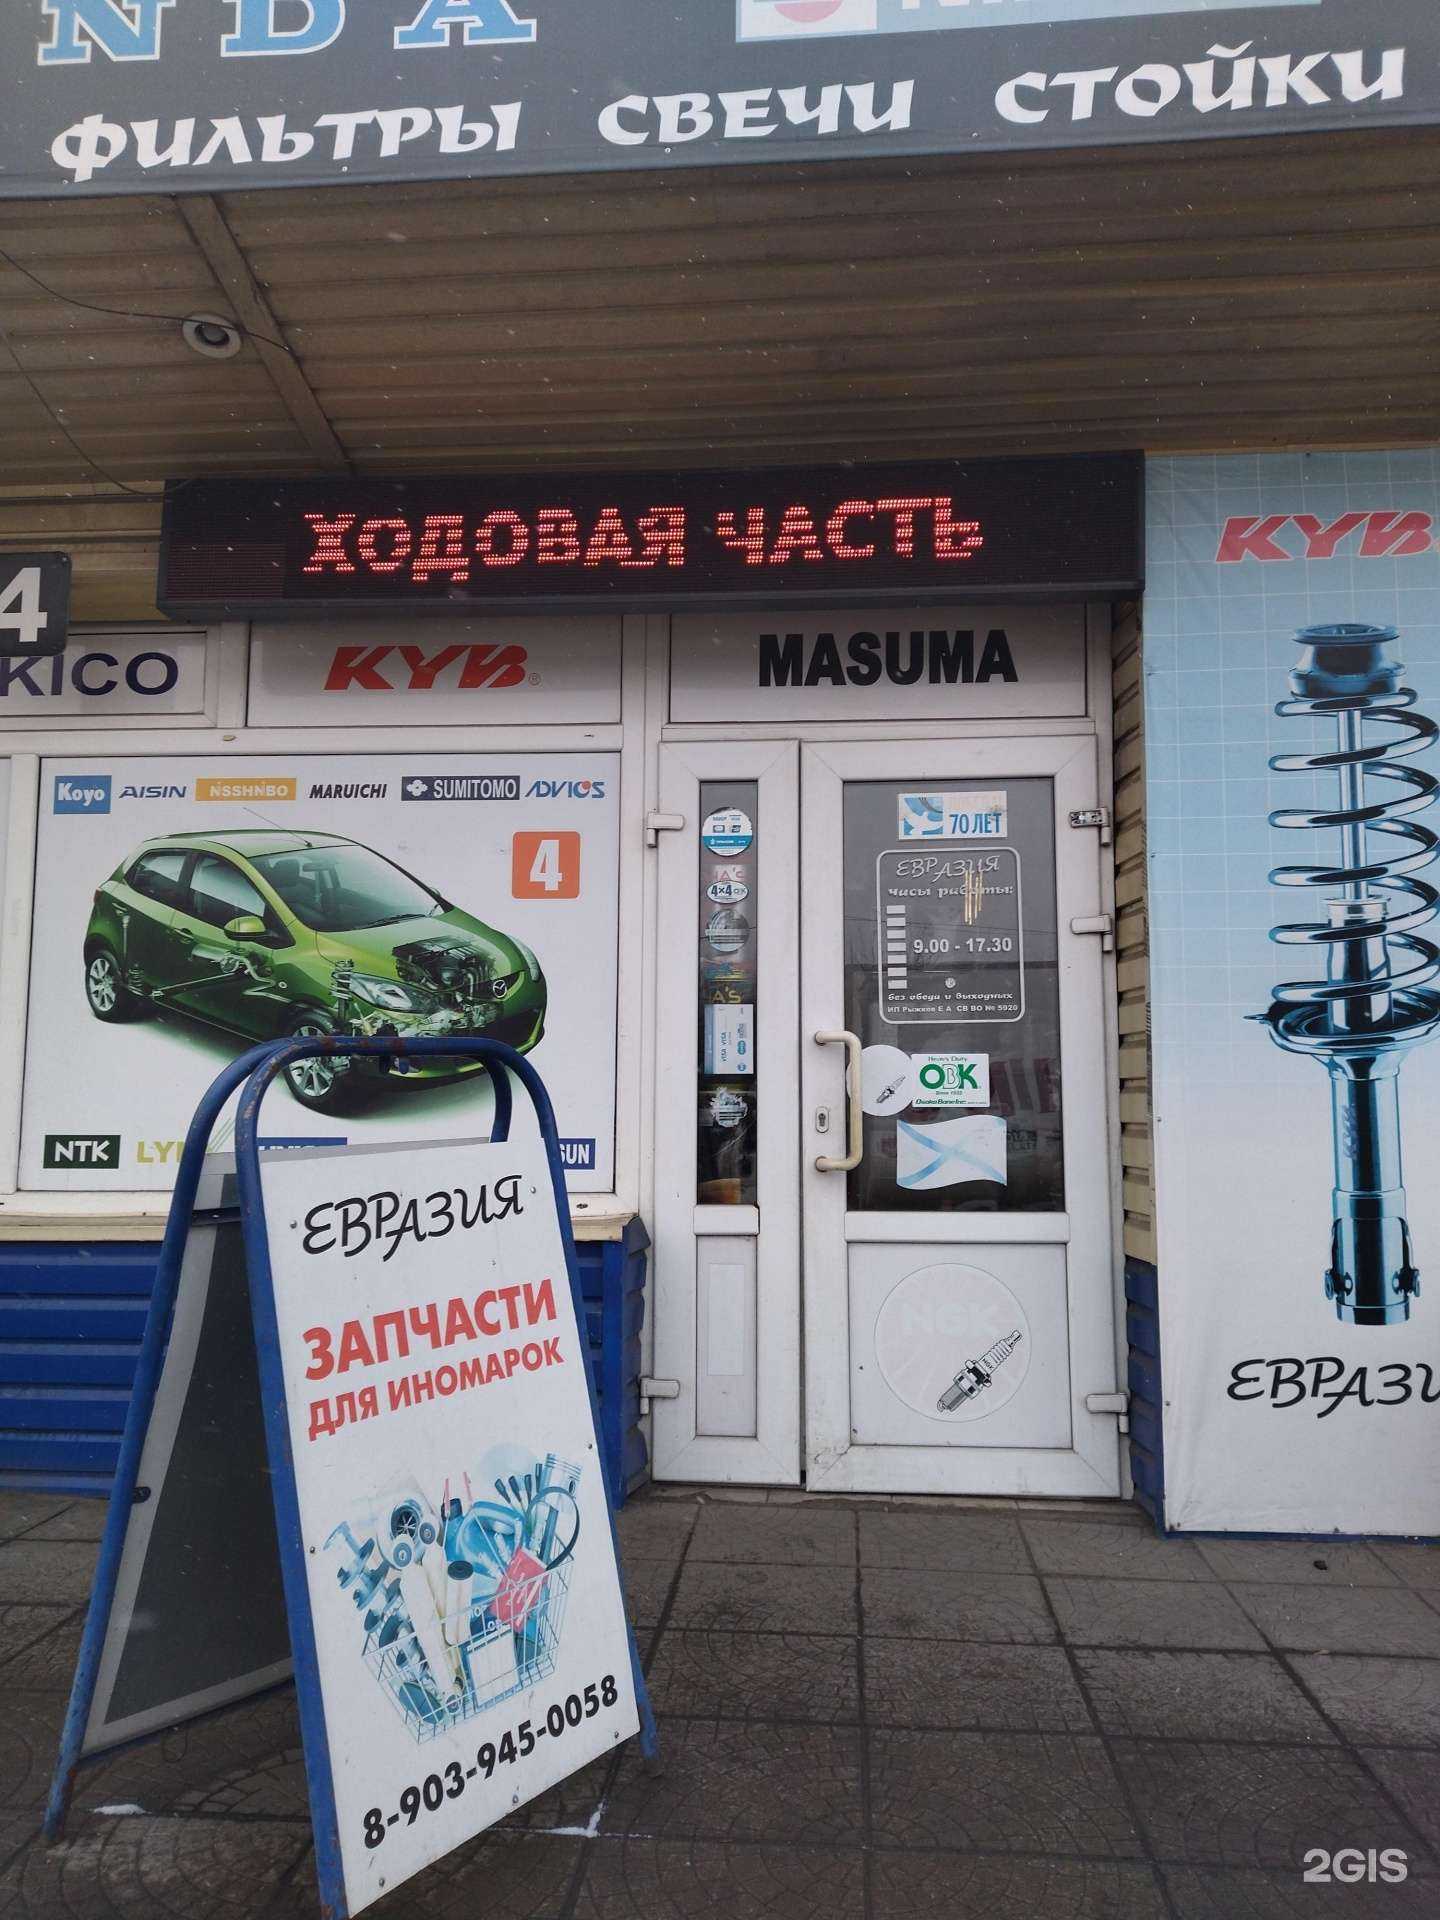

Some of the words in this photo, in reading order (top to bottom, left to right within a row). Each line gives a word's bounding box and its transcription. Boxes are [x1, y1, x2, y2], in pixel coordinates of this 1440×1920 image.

[598, 78, 914, 145] СВЕЧИ
[995, 40, 1405, 124] СТОЙКИ
[303, 506, 685, 582] ХОДОВАЯ
[717, 498, 983, 565] ЧАСТЬ
[1215, 510, 1433, 563] KYB
[0, 567, 48, 642] 4
[0, 652, 179, 697] KICO
[323, 644, 528, 690] KYB
[758, 629, 1018, 687] MASUMA
[57, 782, 105, 807] Koyo
[119, 785, 187, 799] AISIN
[309, 783, 387, 799] MARUICHI
[433, 779, 517, 799] SUMITOMO
[525, 779, 606, 799] ADVICS
[949, 813, 970, 835] 70
[972, 812, 1003, 834] ЛЕТ
[529, 839, 563, 892] 4
[895, 855, 1001, 883] ЕВРАЗИЯ
[913, 938, 950, 954] 9.00
[966, 937, 1013, 952] 17.30
[919, 1063, 979, 1090] OBK
[54, 1139, 111, 1162] NTK
[302, 1174, 524, 1262] ЕВРАЗИЯ
[302, 1278, 557, 1380] ЗАПЧАСТИ
[308, 1385, 379, 1442] ДЛЯ
[387, 1336, 564, 1411] ИНОМАРОК
[363, 1675, 618, 1849] 8-903-945-0058
